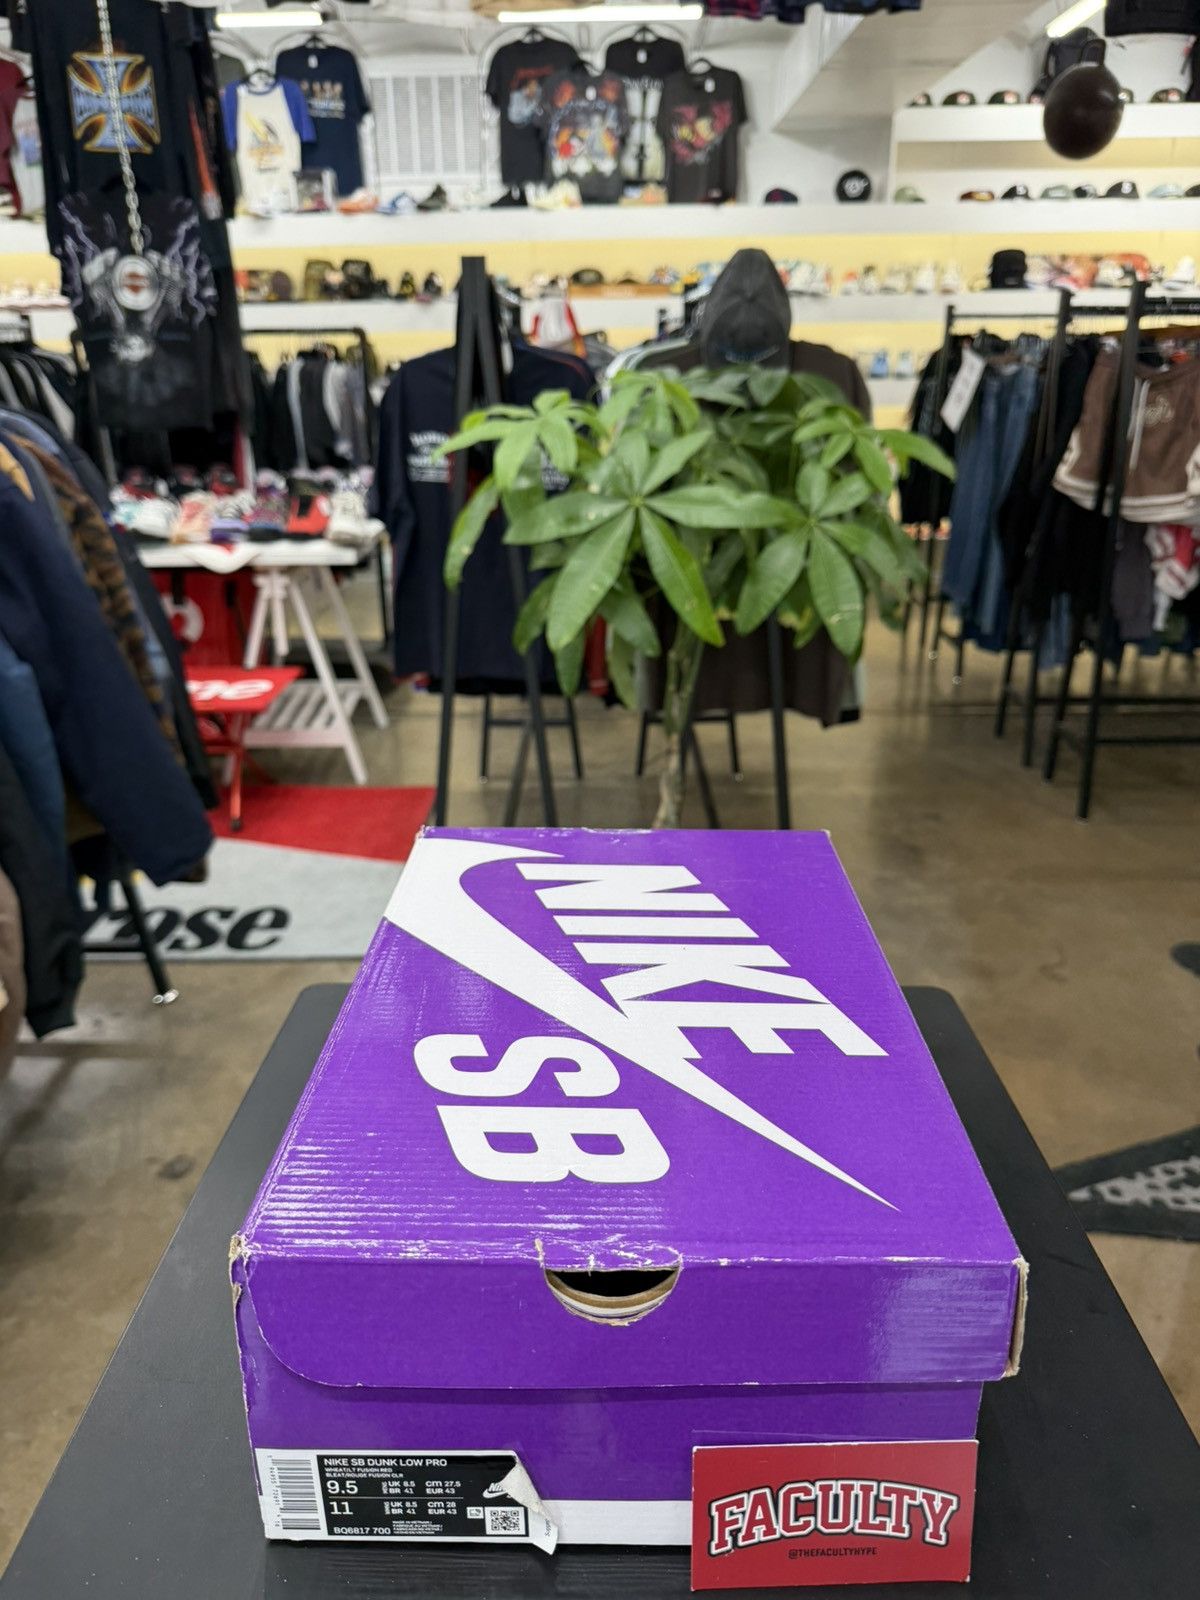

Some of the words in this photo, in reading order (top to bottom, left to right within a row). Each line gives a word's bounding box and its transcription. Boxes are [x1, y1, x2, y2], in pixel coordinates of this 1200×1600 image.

[516, 863, 890, 1057] NIKE
[413, 1034, 671, 1184] SB
[324, 1458, 349, 1466] NIKE
[351, 1458, 365, 1466] SB
[367, 1458, 398, 1466] DUNK
[400, 1458, 423, 1467] LOW
[425, 1458, 448, 1467] PRO
[326, 1480, 359, 1494] 9.5
[329, 1501, 353, 1515] 11
[709, 1479, 960, 1556] FACULTY
[788, 1547, 878, 1559] @THEFACULTYHYPE
